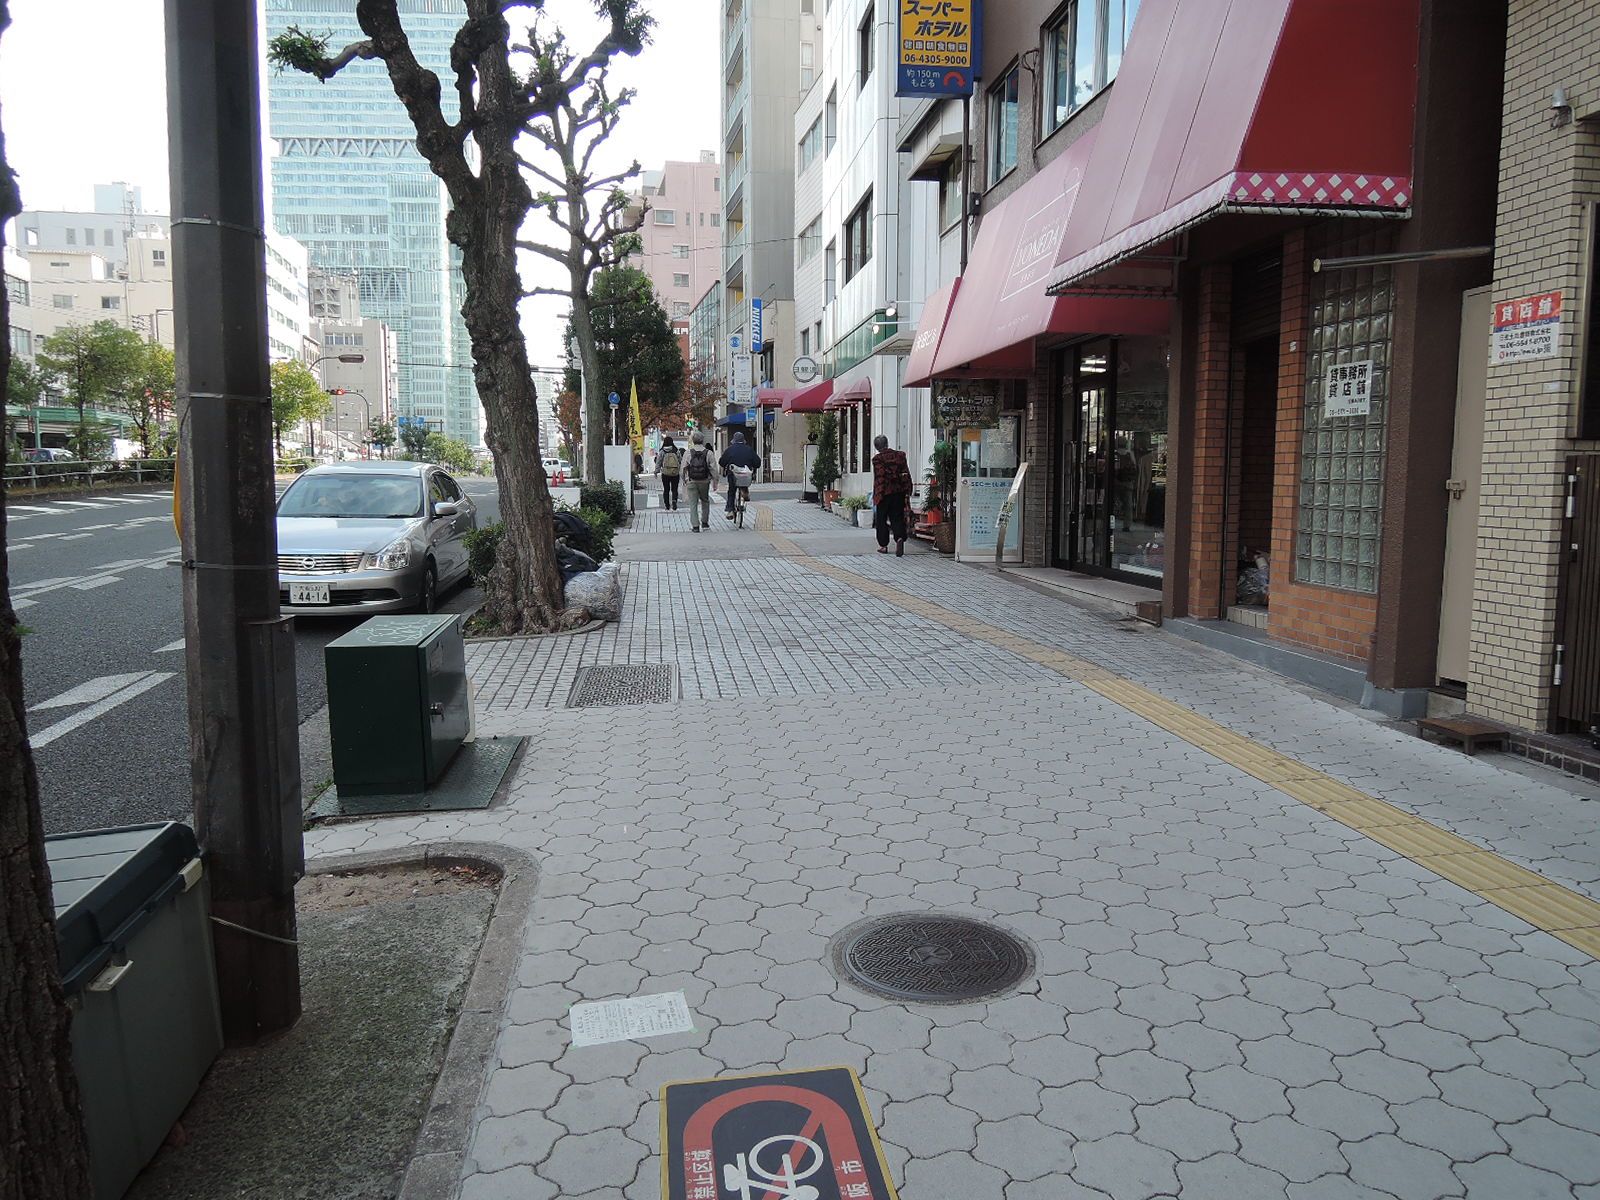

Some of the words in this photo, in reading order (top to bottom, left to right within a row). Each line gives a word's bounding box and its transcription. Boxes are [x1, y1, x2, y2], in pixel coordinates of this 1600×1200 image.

[903, 0, 965, 17] スーパー
[914, 20, 968, 37] ホテル
[904, 54, 967, 64] 06-4305-9000
[906, 69, 915, 78] 約
[917, 70, 931, 78] 150
[911, 79, 935, 88] もどる
[1501, 297, 1552, 322] 貸店舗
[752, 307, 760, 344] NIKKEI
[1330, 364, 1367, 382] 貸事務所
[298, 592, 328, 601] 44-14
